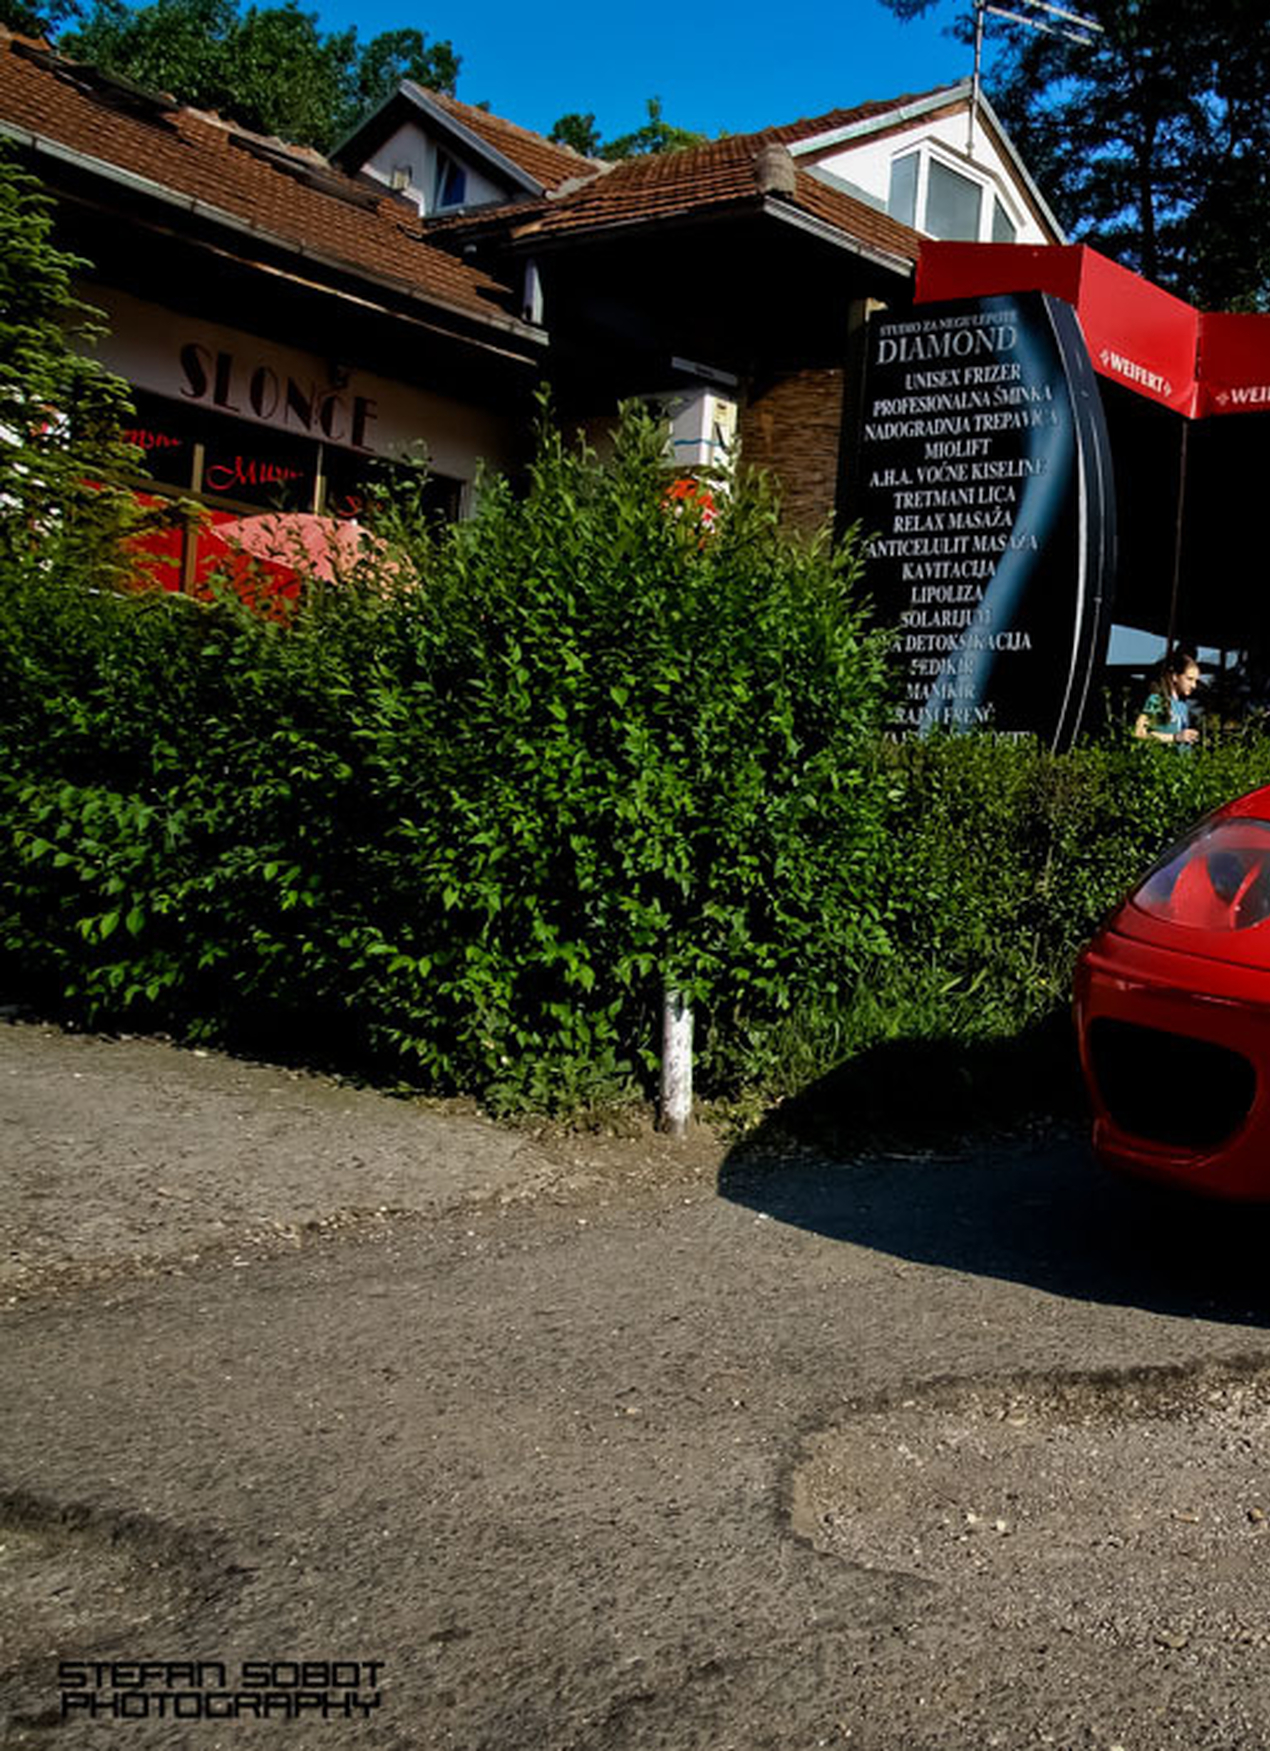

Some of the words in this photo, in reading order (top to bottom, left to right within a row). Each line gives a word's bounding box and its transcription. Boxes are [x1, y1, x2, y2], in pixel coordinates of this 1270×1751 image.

[875, 325, 1018, 365] DIAMOND
[906, 368, 959, 391] UNISEX
[965, 364, 1020, 385] FRIZER
[1110, 351, 1164, 393] WEIFERT
[874, 392, 990, 417] PROFESIONALNA
[993, 386, 1052, 408] ŠMINKA
[865, 416, 970, 441] NADOGRADNJA
[925, 439, 991, 460] MIOLIFT
[870, 470, 912, 488] A.H.A.
[917, 462, 967, 484] VOČNE
[972, 459, 1048, 480] KISELINE
[894, 490, 975, 510] TRETMANI
[979, 486, 1015, 504] LICA
[894, 512, 943, 533] RELAX
[949, 507, 1012, 529] MASAŽA
[868, 537, 970, 559] ANTICELULIT
[903, 560, 995, 581] KAVITACIJA
[912, 586, 983, 604] LIPOLIZA
[901, 610, 991, 628] SOLARIJUM
